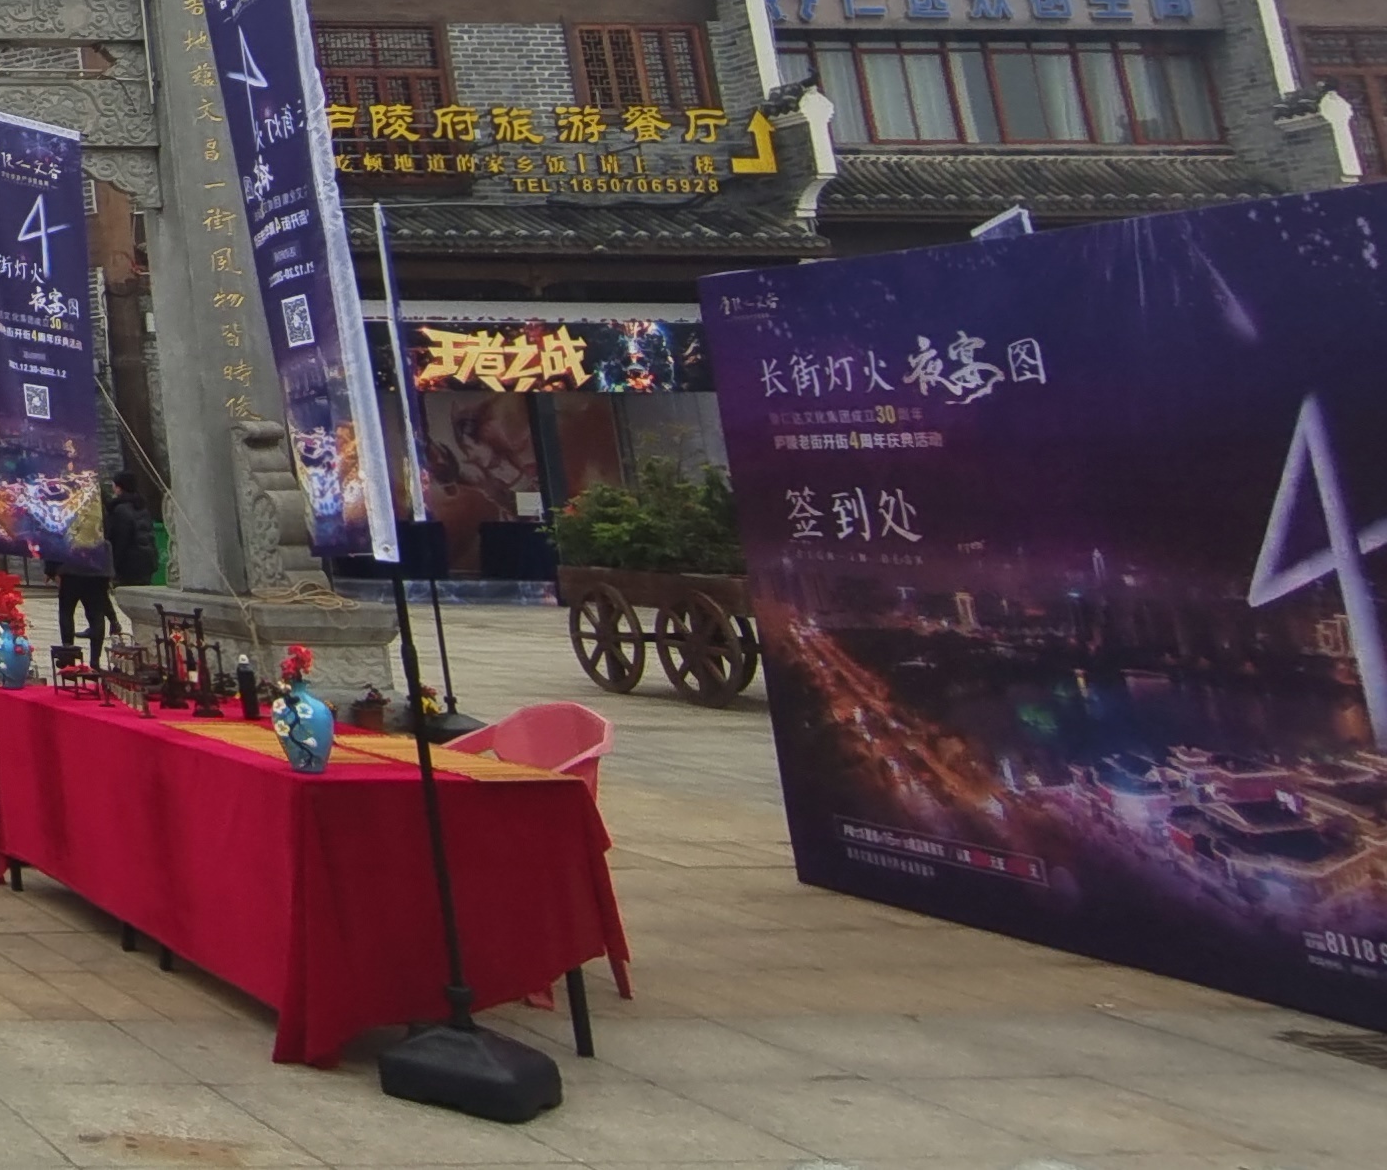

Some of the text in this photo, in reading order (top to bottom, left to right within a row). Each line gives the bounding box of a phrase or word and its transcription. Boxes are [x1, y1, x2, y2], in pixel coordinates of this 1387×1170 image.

[18, 194, 71, 278] 4
[29, 286, 80, 319] 夜宴图
[420, 324, 595, 392] 王者之战
[774, 431, 944, 450] 庐陵老街开街4周年庆典活动
[785, 486, 923, 542] 签到处
